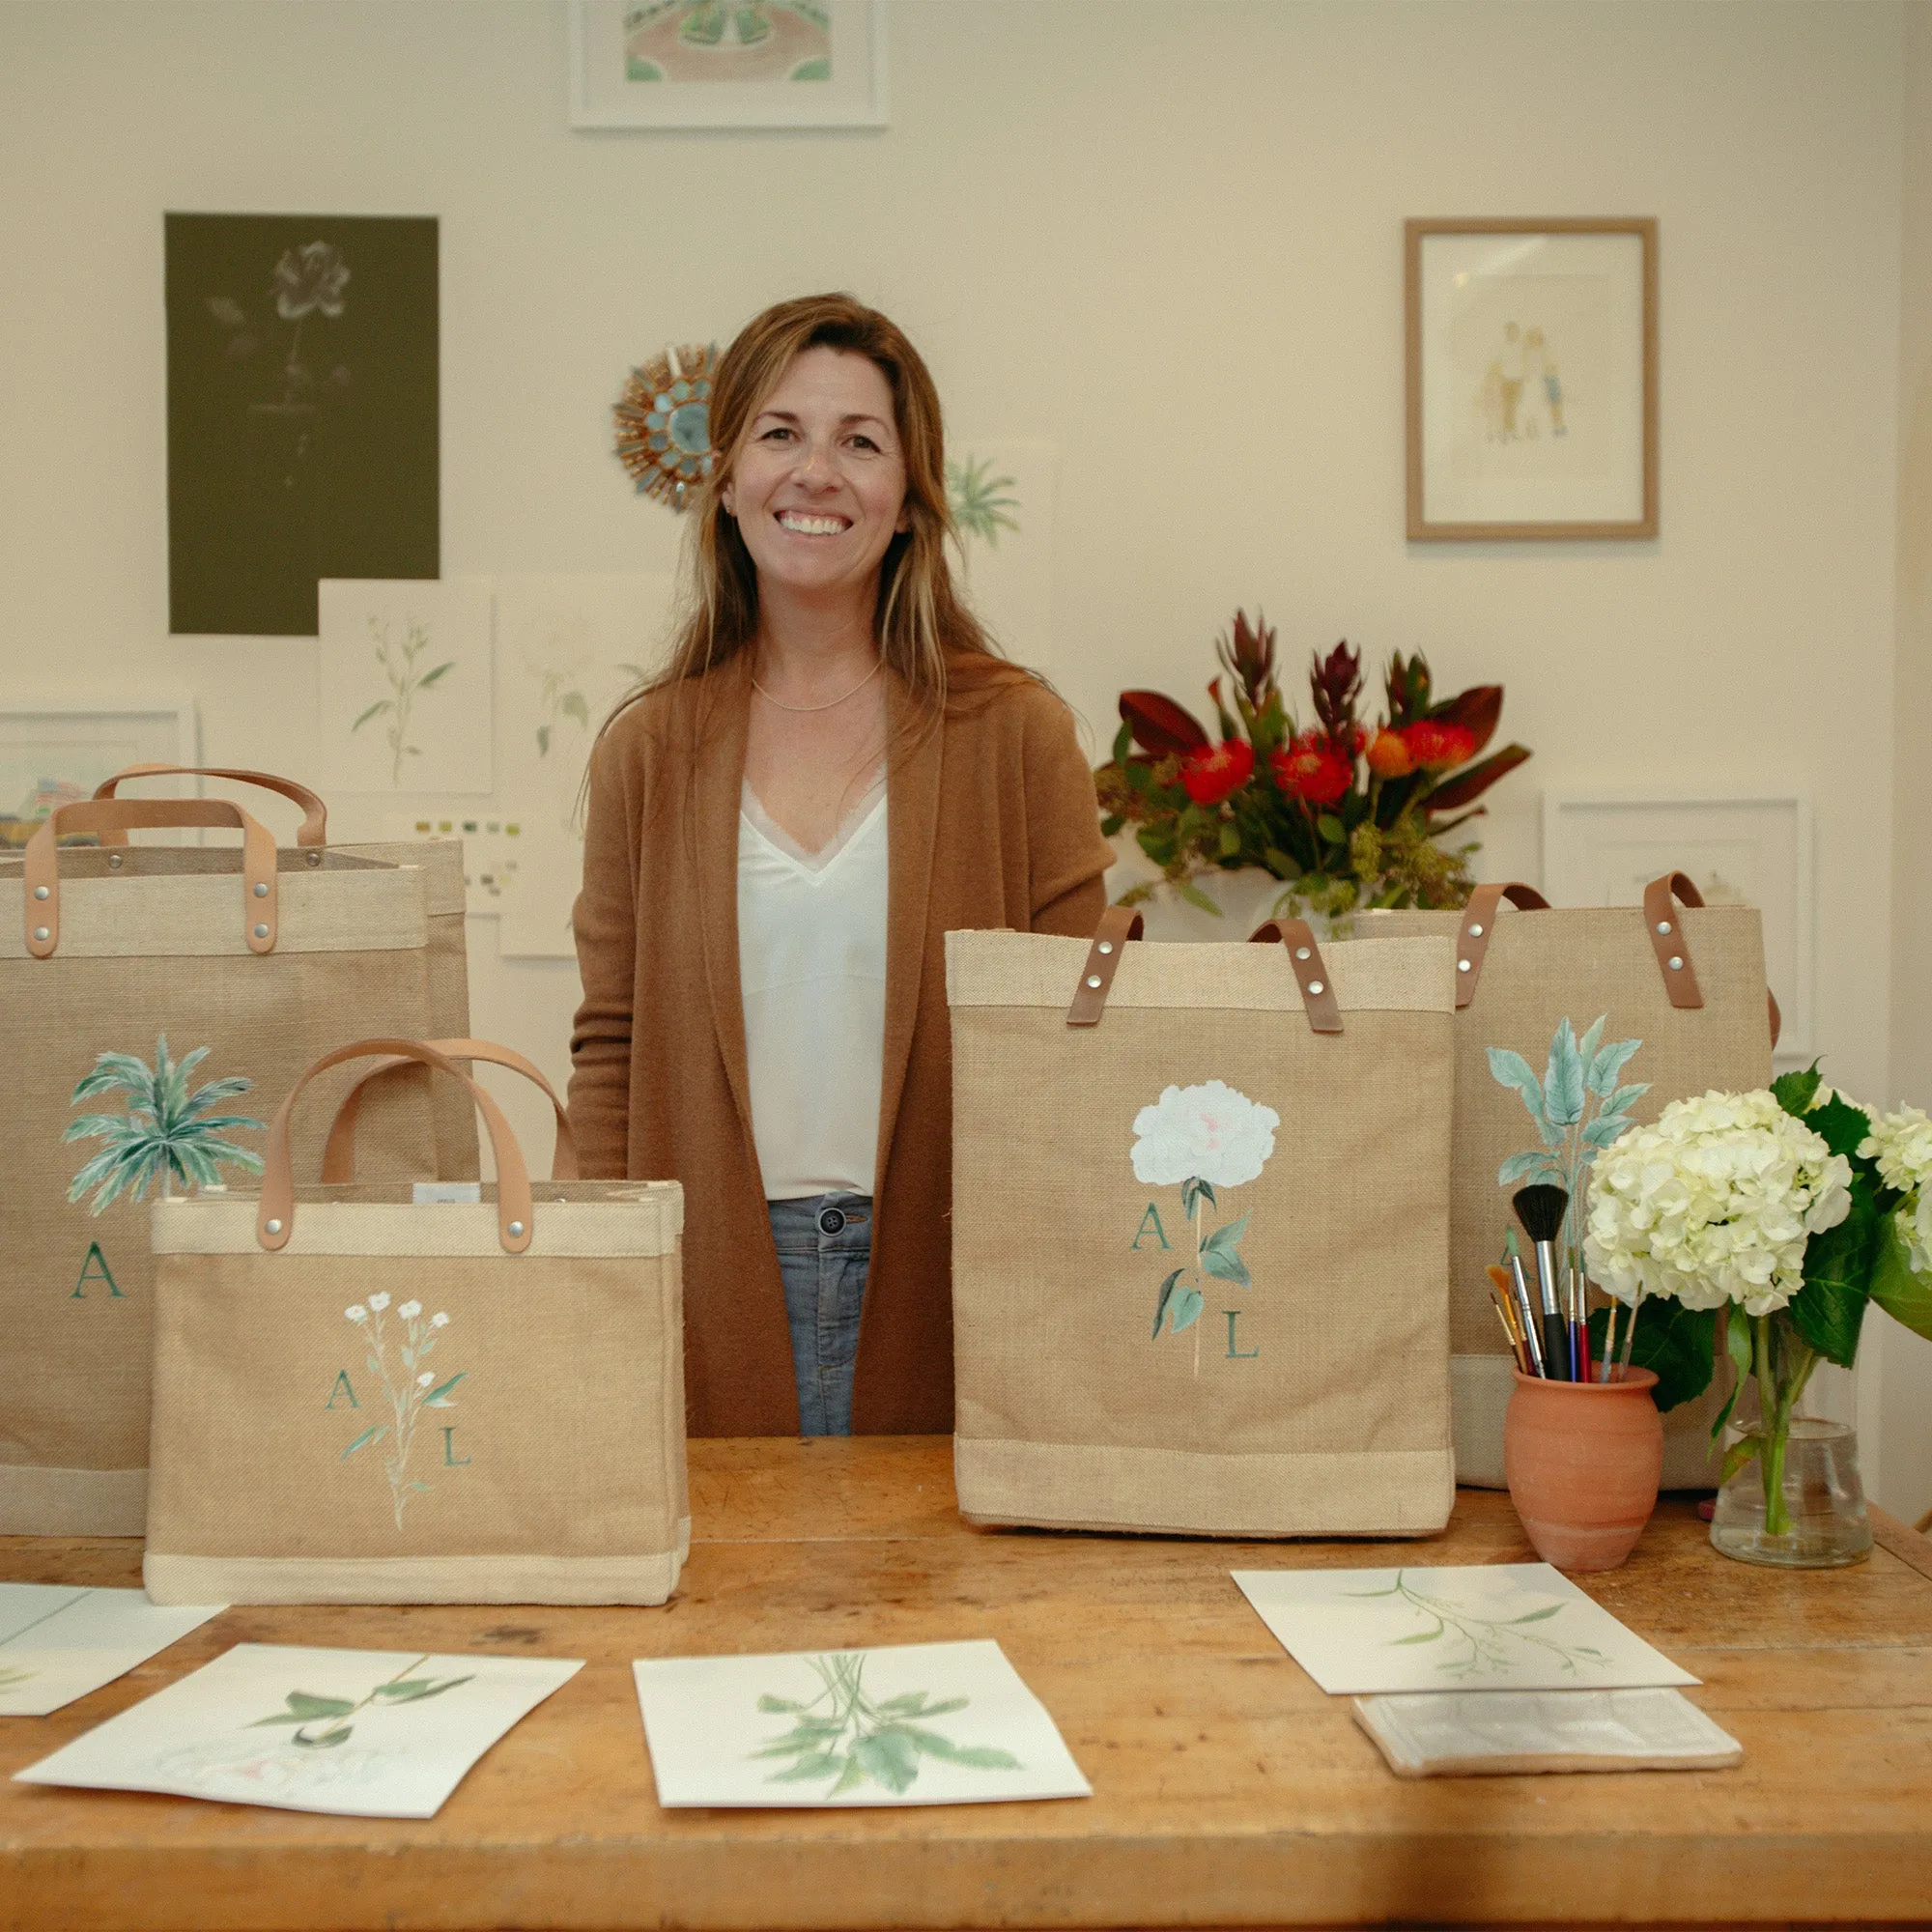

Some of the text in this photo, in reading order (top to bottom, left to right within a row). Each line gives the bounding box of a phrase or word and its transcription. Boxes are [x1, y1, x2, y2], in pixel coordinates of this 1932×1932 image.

[1129, 1202, 1174, 1250] A
[70, 1241, 128, 1298] A
[1222, 1311, 1260, 1358] L
[325, 1369, 360, 1409] A
[440, 1427, 471, 1466] L
